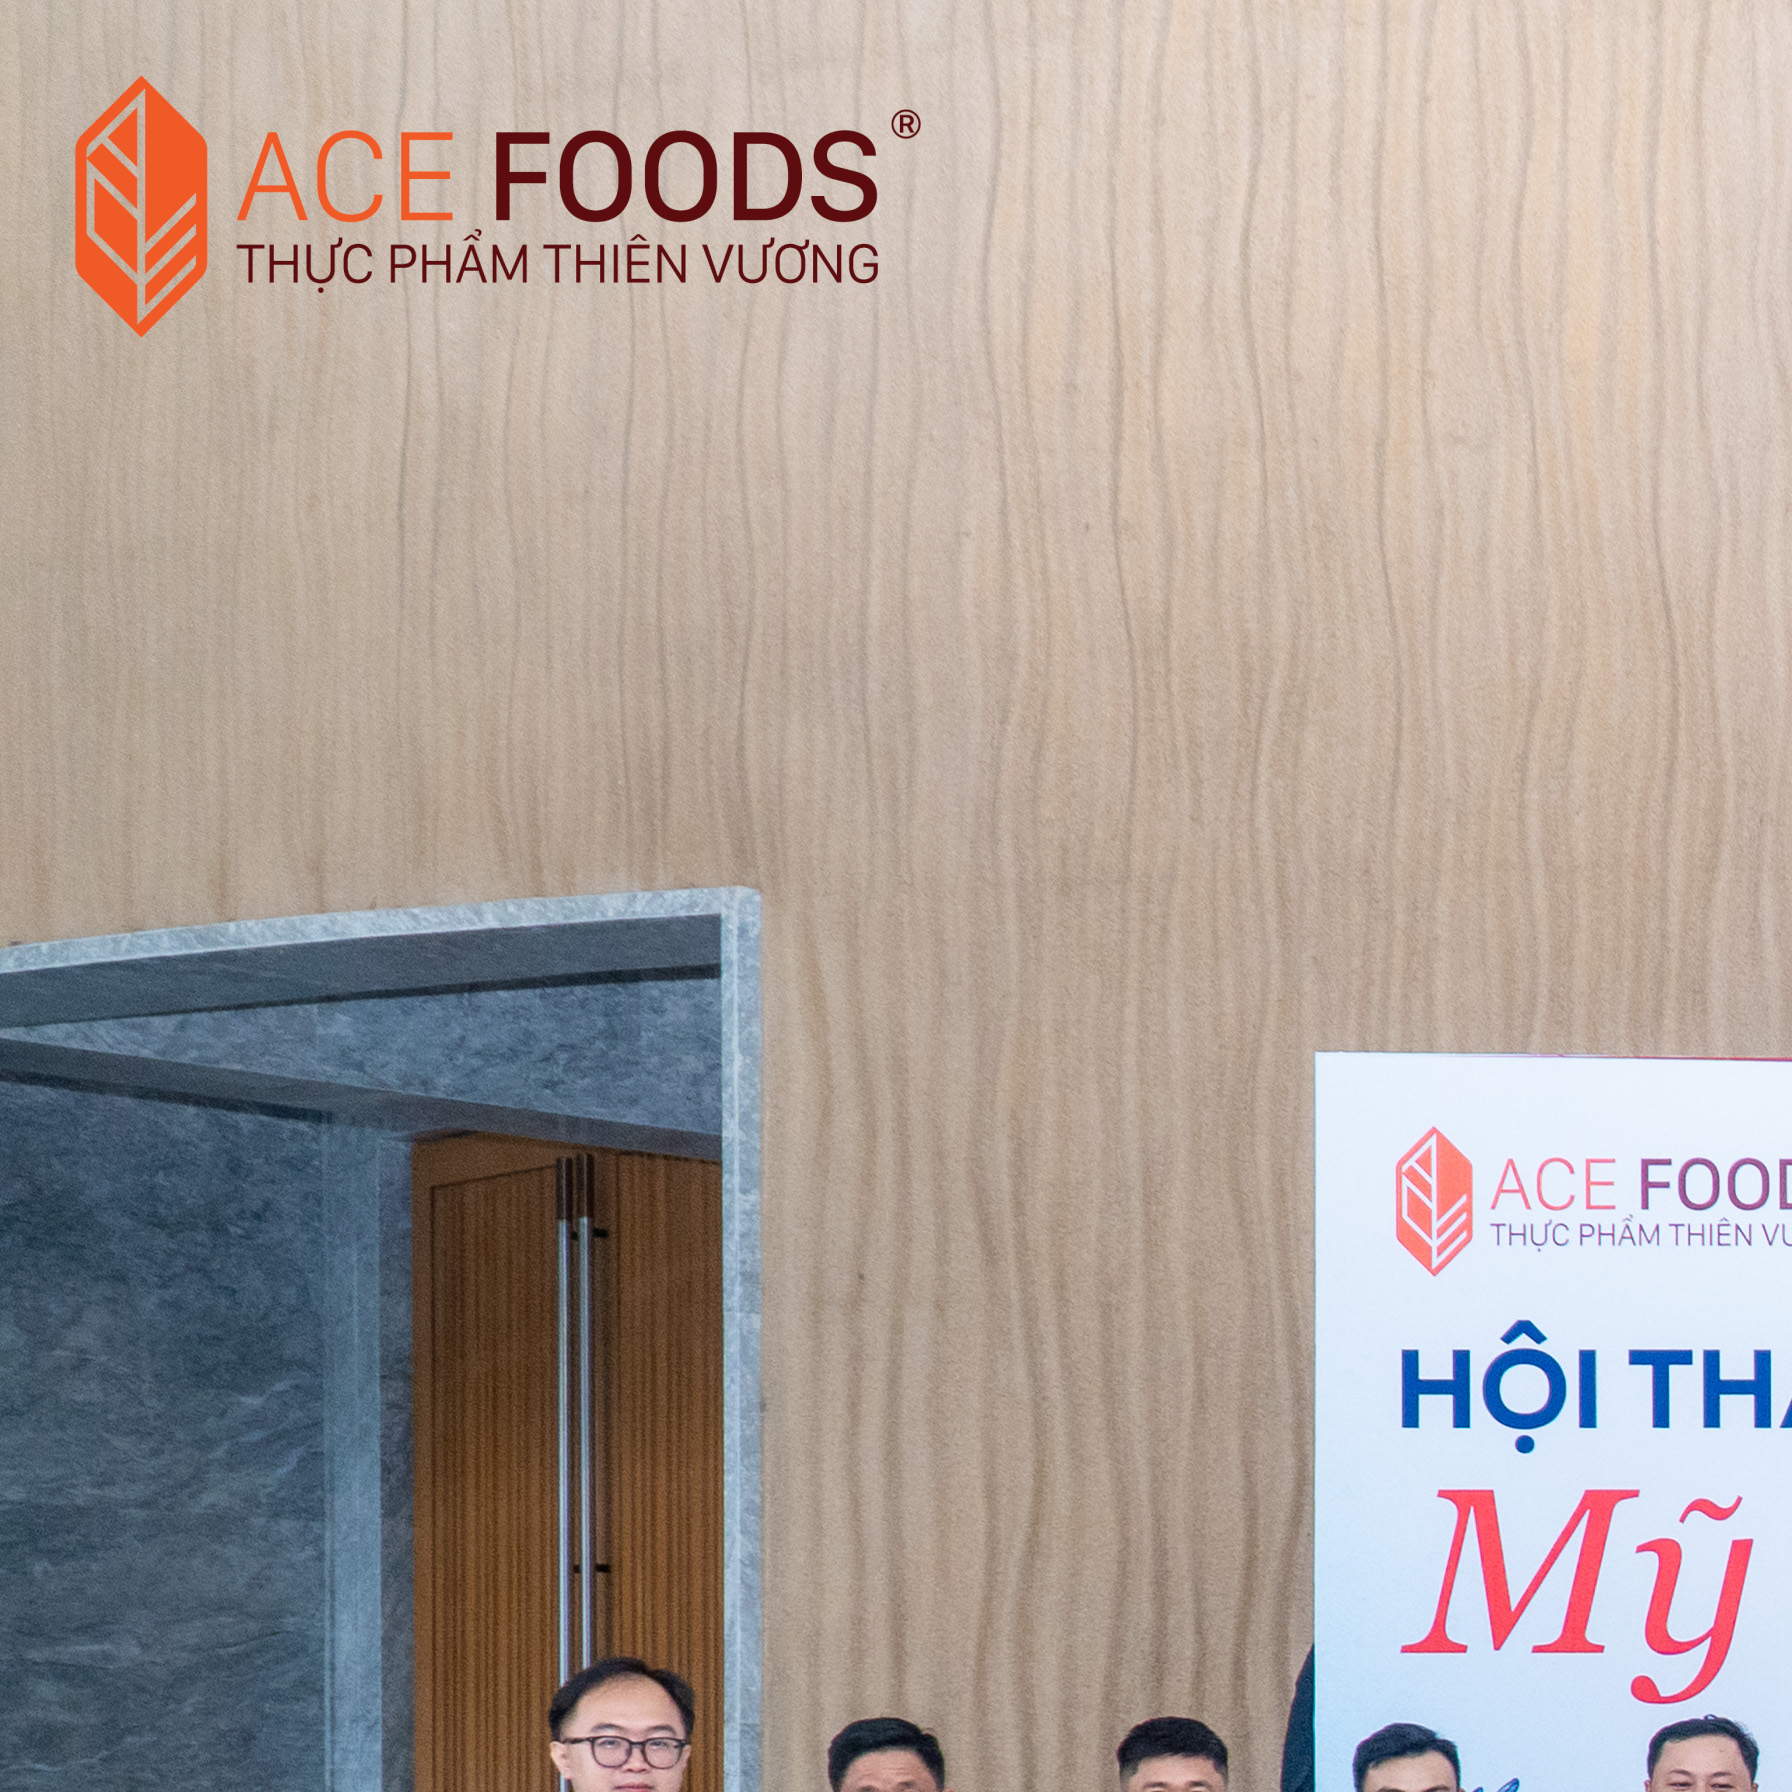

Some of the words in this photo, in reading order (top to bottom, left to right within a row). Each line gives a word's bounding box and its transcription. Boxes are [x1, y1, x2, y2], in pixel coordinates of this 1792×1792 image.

[1490, 1158, 1616, 1211] ACE
[1490, 1218, 1569, 1252] THỰC
[1579, 1214, 1661, 1248] PHẨM
[1668, 1217, 1753, 1247] THIÊN
[1400, 1319, 1597, 1454] HỘI
[1401, 1488, 1754, 1704] Mỹ
